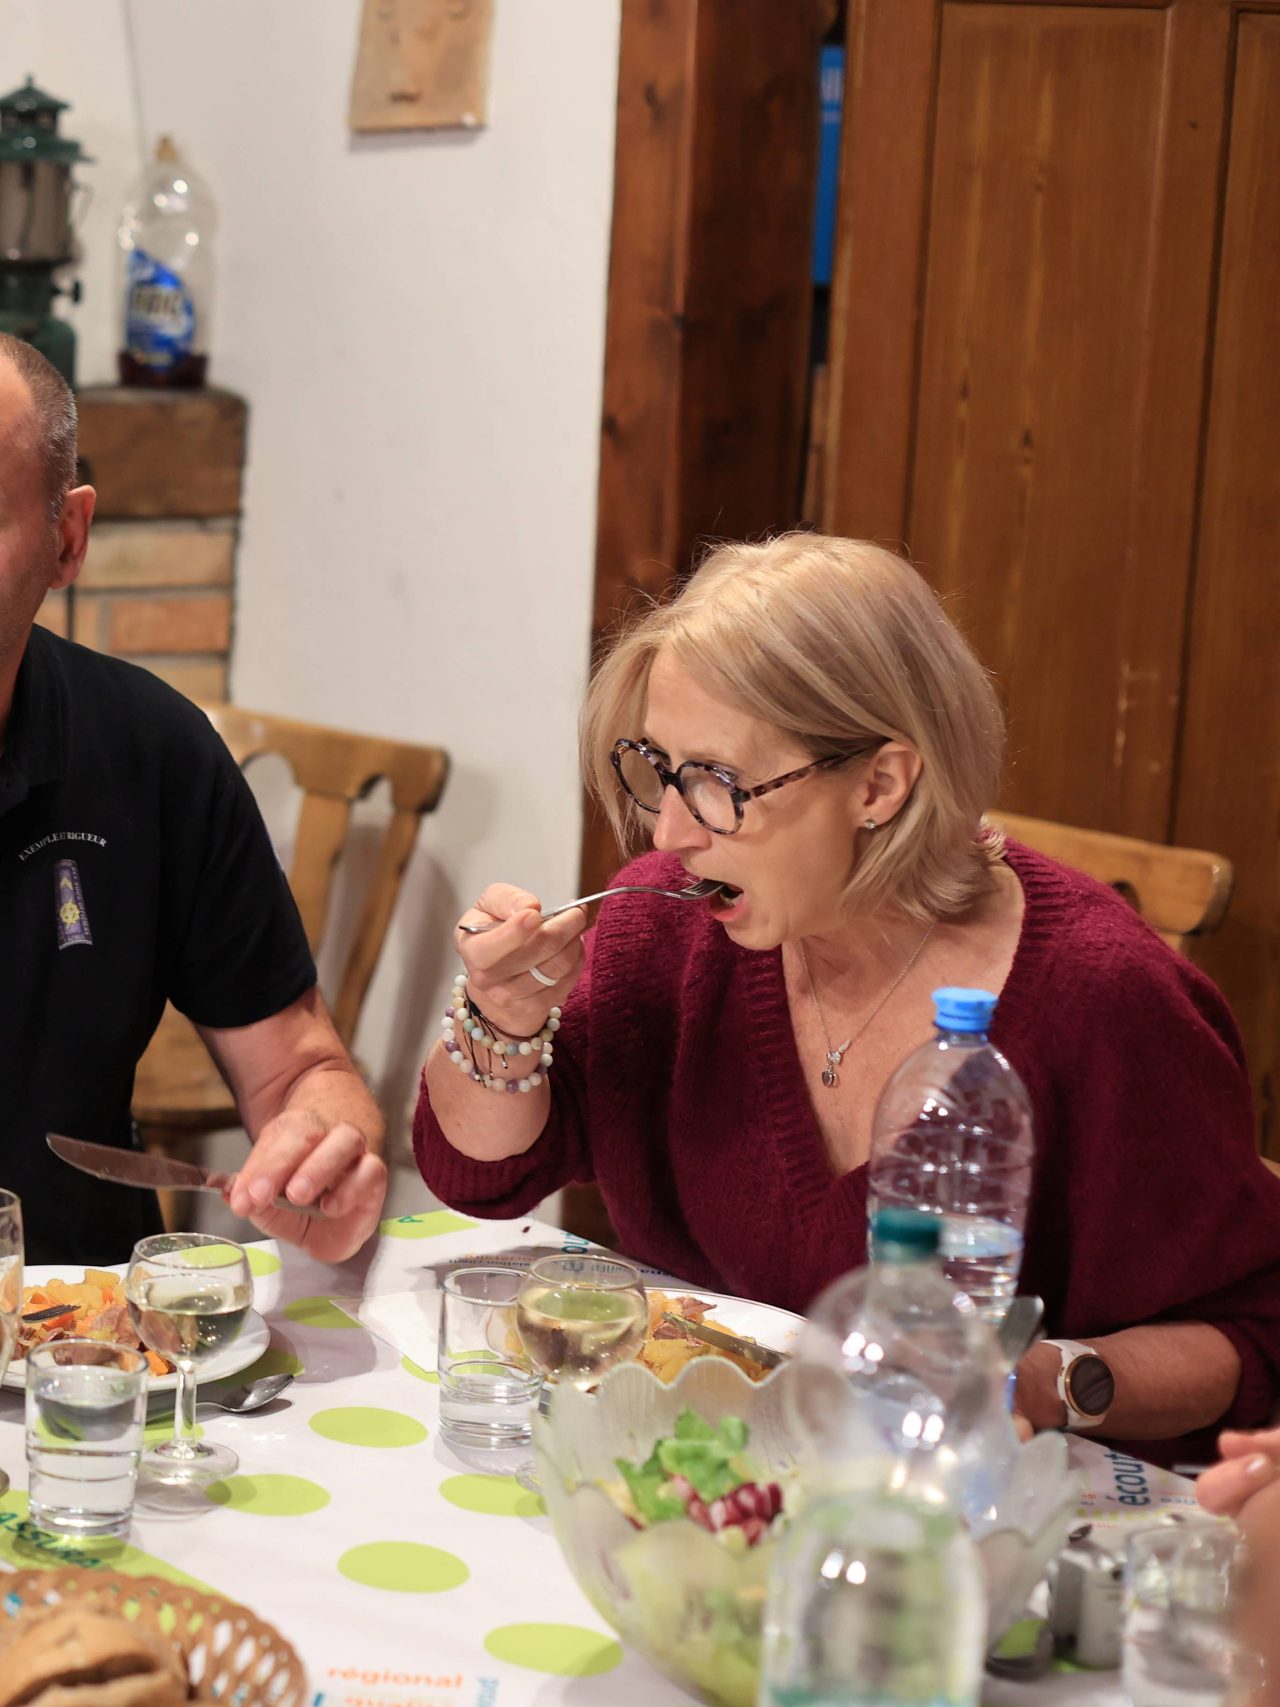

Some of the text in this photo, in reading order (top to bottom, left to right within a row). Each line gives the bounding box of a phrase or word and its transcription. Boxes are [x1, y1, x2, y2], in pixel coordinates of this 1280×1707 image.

[67, 832, 107, 847] RIGUEUR
[1104, 1451, 1150, 1506] écout
[327, 1666, 463, 1689] régional
